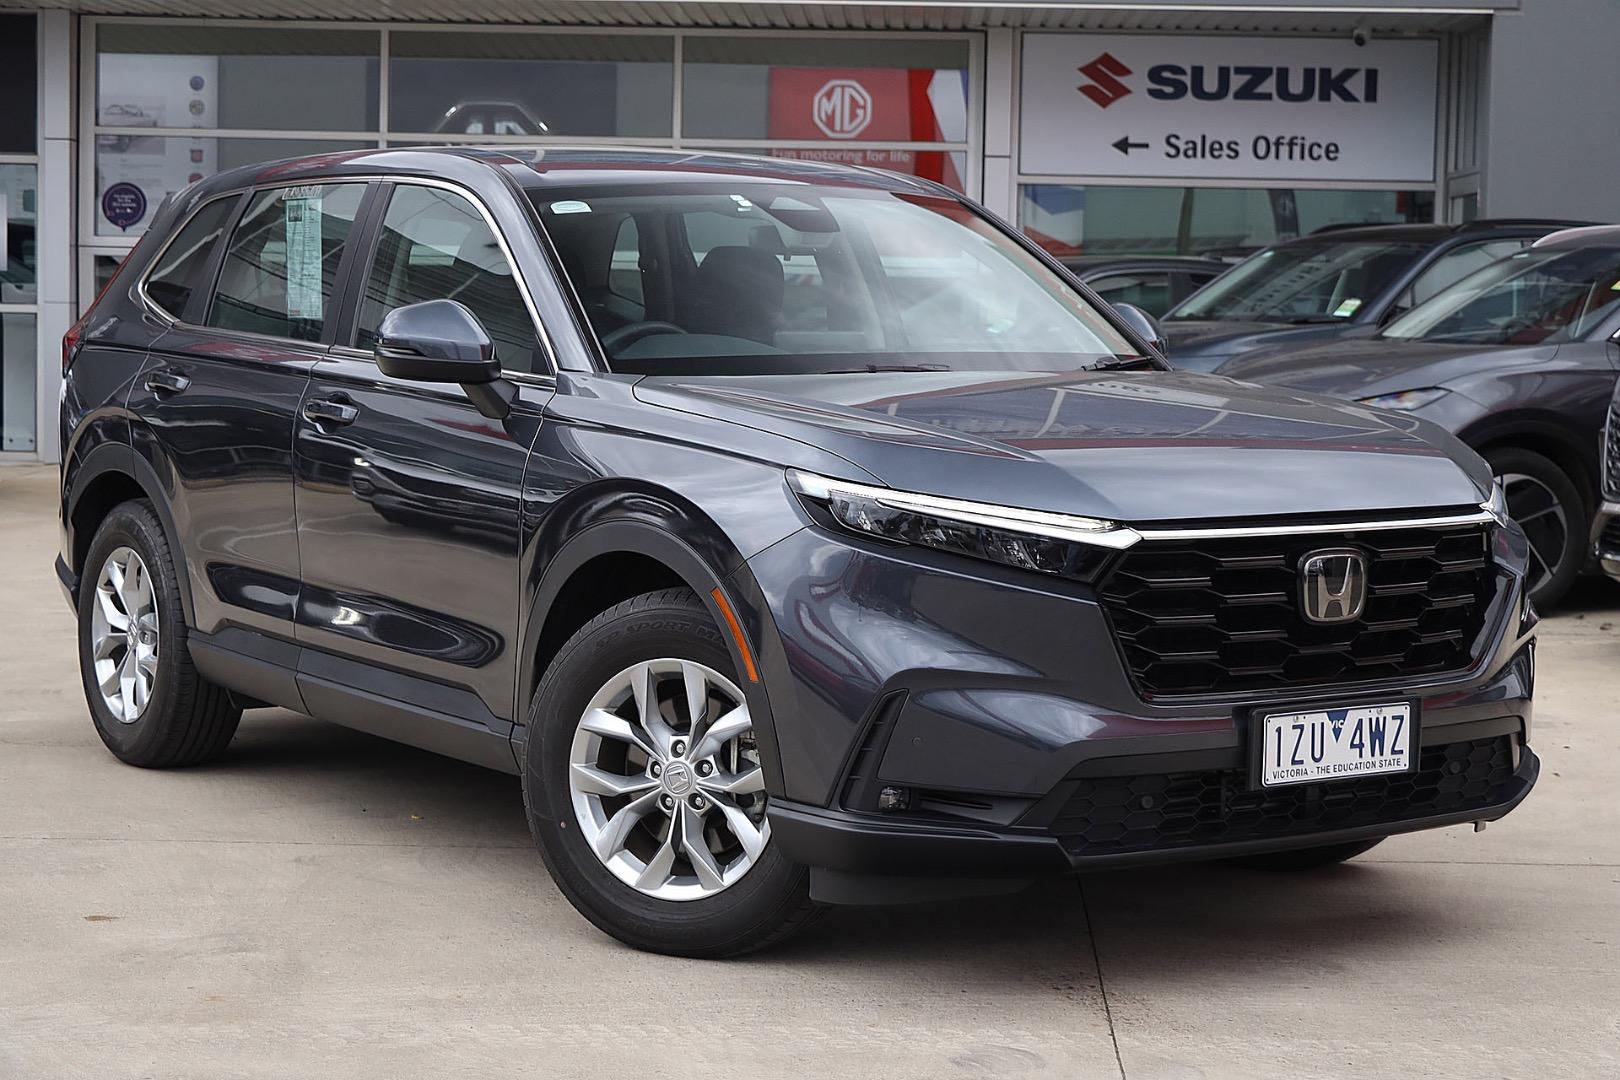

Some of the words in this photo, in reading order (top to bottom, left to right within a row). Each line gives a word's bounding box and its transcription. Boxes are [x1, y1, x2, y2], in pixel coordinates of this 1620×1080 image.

[1147, 63, 1379, 103] SUZUKI
[800, 150, 863, 164] motoring
[866, 150, 885, 162] for
[889, 151, 910, 162] life
[1164, 133, 1240, 160] Sales
[1252, 135, 1340, 161] Office
[626, 620, 691, 633] SPORT
[1330, 720, 1345, 729] VIC
[1349, 715, 1405, 759] 4WZ
[1272, 767, 1309, 780] VICTORIA
[1316, 765, 1331, 775] THE
[1333, 760, 1377, 773] EDUCATION
[1379, 757, 1401, 768] STATE
